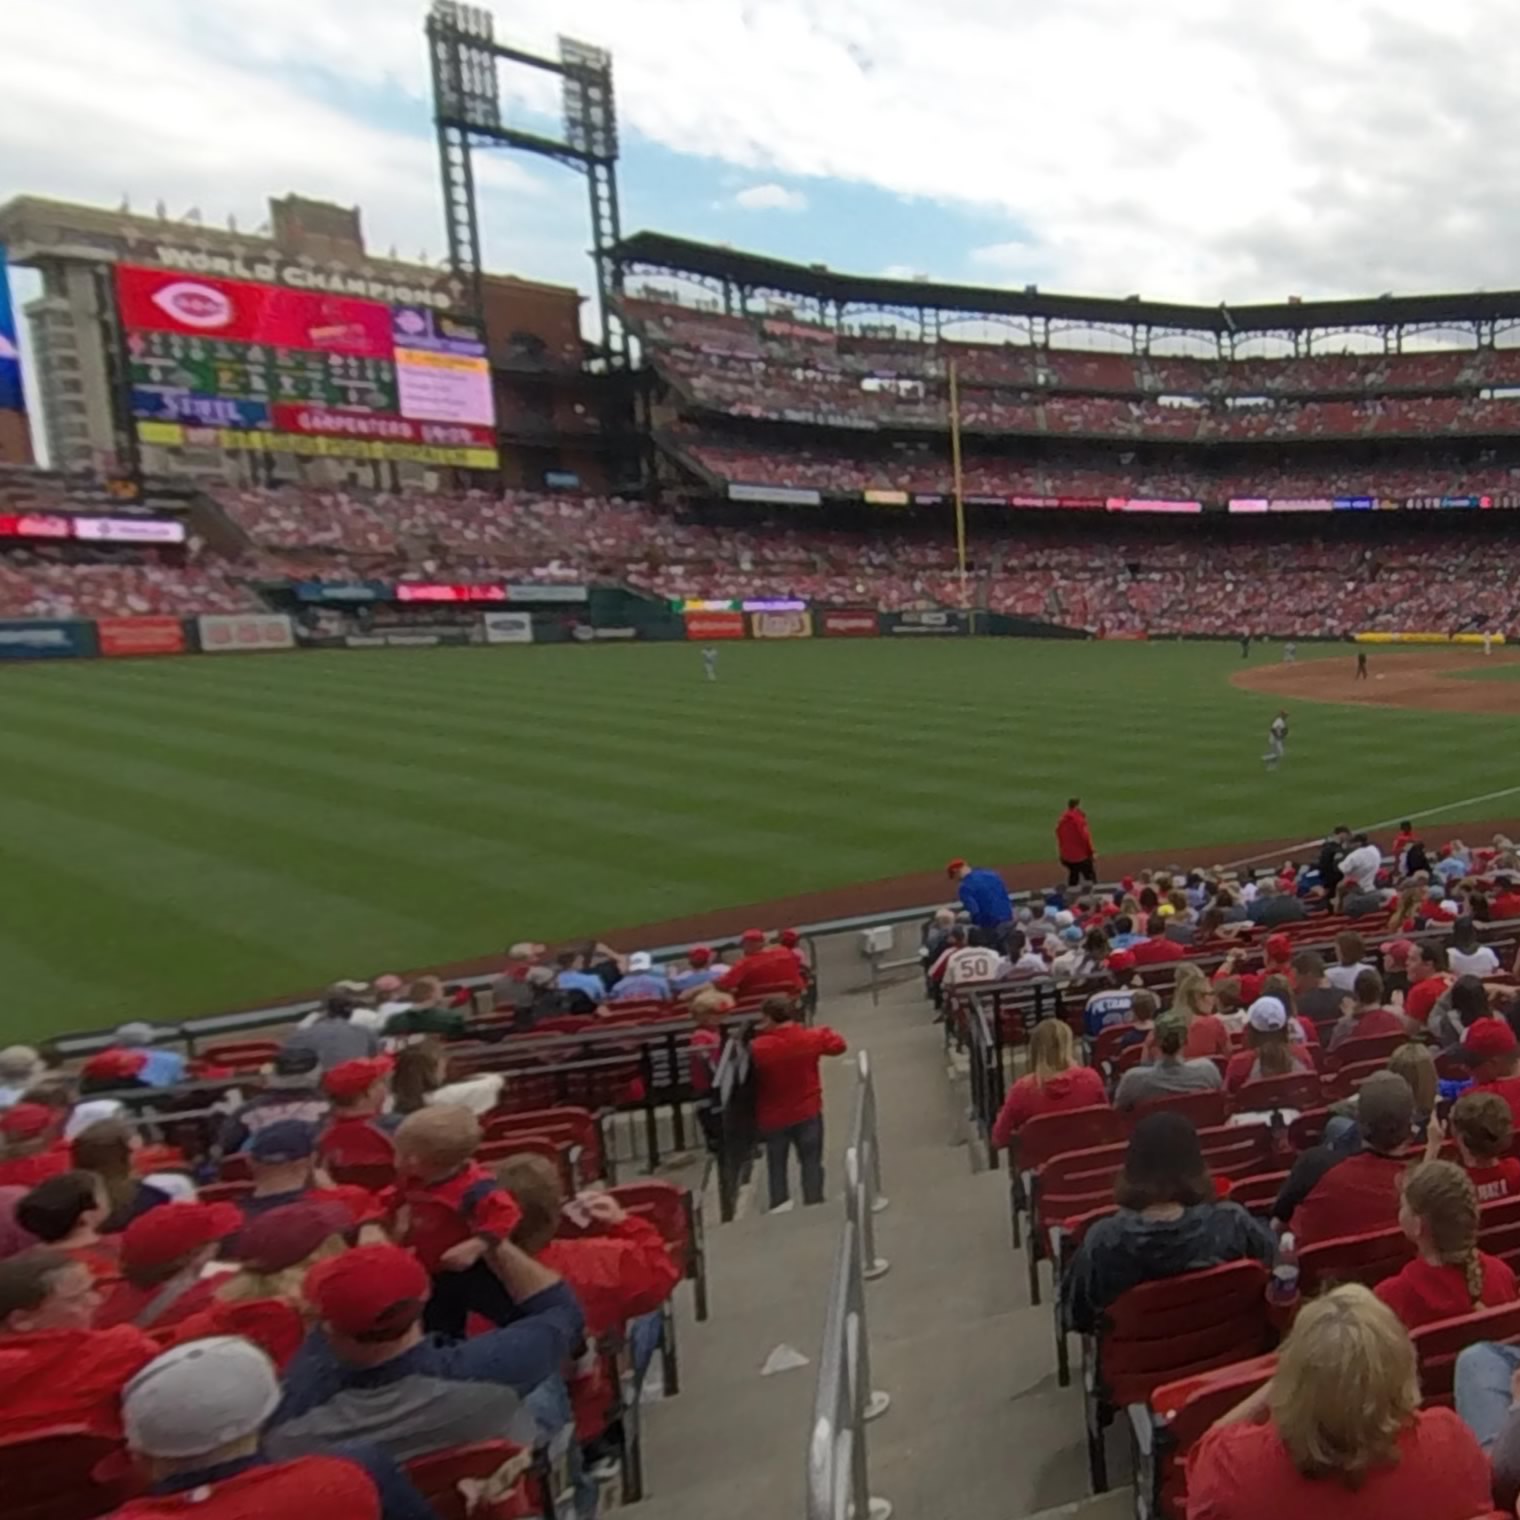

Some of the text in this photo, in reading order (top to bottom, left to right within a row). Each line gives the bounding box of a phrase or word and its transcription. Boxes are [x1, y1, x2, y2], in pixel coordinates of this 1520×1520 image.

[157, 246, 451, 309] WORLD CHAMPIONS
[298, 411, 415, 439] CARPENTERS
[961, 958, 989, 978] 50
